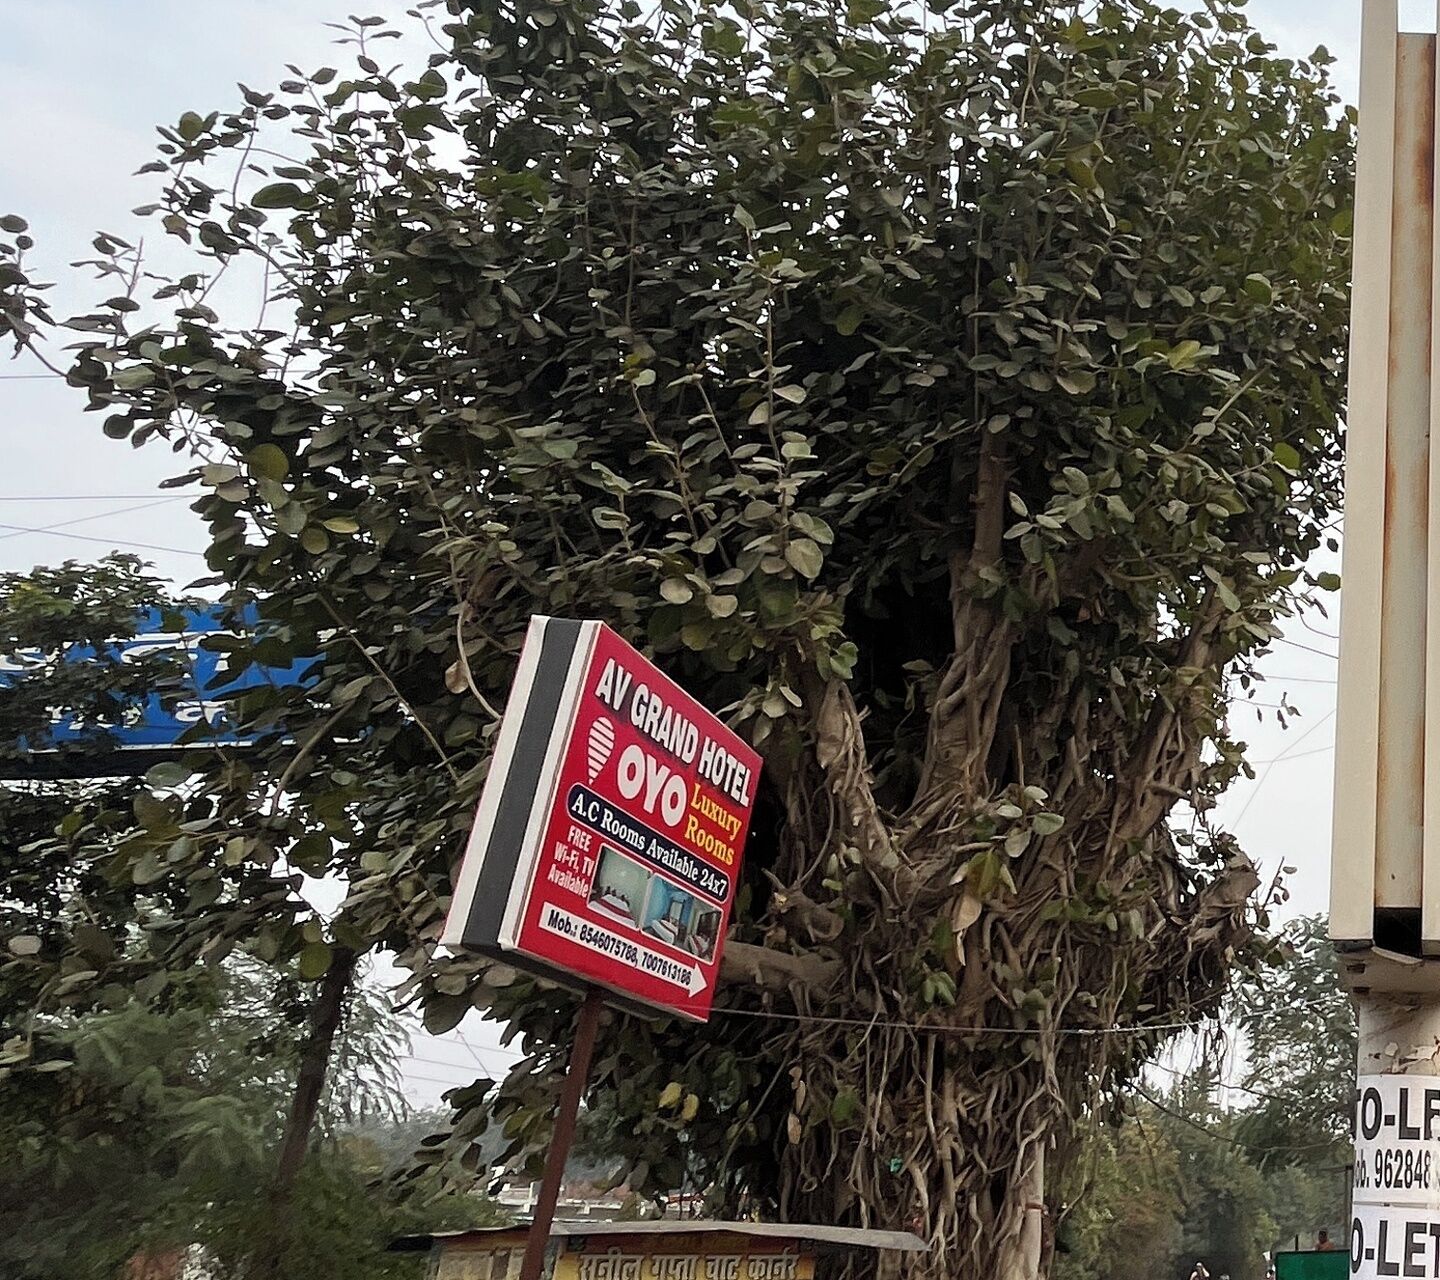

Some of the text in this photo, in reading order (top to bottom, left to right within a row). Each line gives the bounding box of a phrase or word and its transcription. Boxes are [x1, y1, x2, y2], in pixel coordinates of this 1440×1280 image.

[595, 658, 753, 808] AV GRAND HOTEL
[617, 744, 688, 828] OYO
[690, 783, 742, 841] Luxury
[567, 824, 592, 852] FREE
[571, 792, 728, 896] A.C Rooms Available 24x7
[684, 814, 735, 866] Rooms
[547, 863, 590, 899] Available
[581, 856, 595, 877] TV
